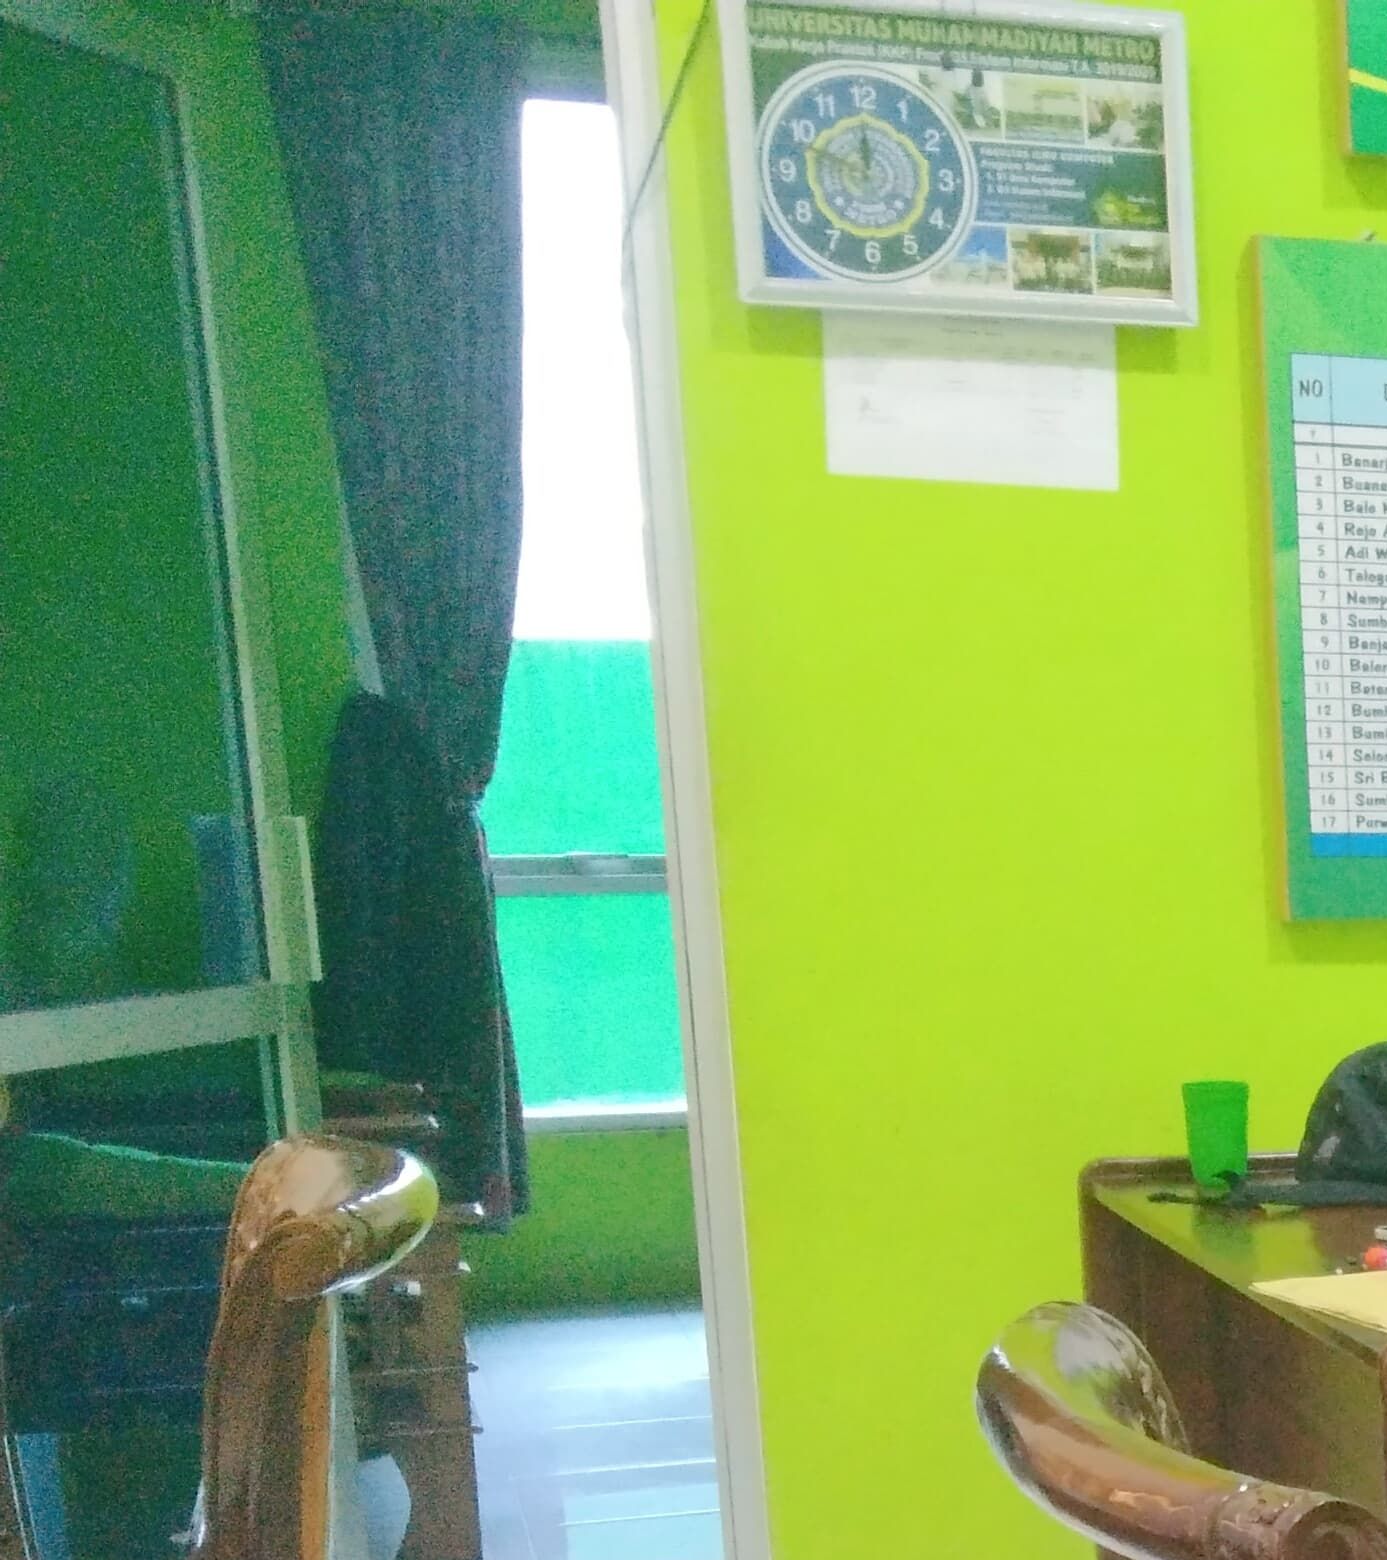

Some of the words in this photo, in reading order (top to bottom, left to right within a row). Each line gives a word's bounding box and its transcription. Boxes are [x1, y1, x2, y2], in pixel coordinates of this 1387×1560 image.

[747, 7, 890, 39] UNIVERSITAS
[1084, 37, 1155, 61] METRO
[851, 87, 876, 109] 12
[815, 95, 835, 117] 11
[897, 101, 908, 121] 1
[792, 120, 815, 141] 10
[924, 130, 939, 151] 2
[780, 159, 796, 182] 9
[938, 169, 953, 191] 3
[796, 200, 812, 222] 8
[929, 208, 944, 229] 4
[825, 230, 840, 250] 7
[904, 235, 918, 255] 5
[865, 242, 880, 263] 6
[1299, 380, 1322, 397] NO
[1315, 453, 1320, 463] 1
[1315, 476, 1322, 487] 2
[1316, 499, 1322, 511] 3
[1317, 522, 1323, 534] 4
[1318, 545, 1324, 557] 5
[1318, 568, 1325, 579] 6
[1319, 591, 1326, 602] 7
[1321, 614, 1327, 626] 8
[1321, 637, 1328, 648] 9
[1315, 660, 1329, 672] 10
[1317, 705, 1331, 716] 12
[1318, 728, 1332, 739] 13
[1318, 750, 1333, 761] 14
[1321, 772, 1334, 784] 15
[1321, 794, 1335, 806] 16
[1322, 817, 1336, 828] 17
